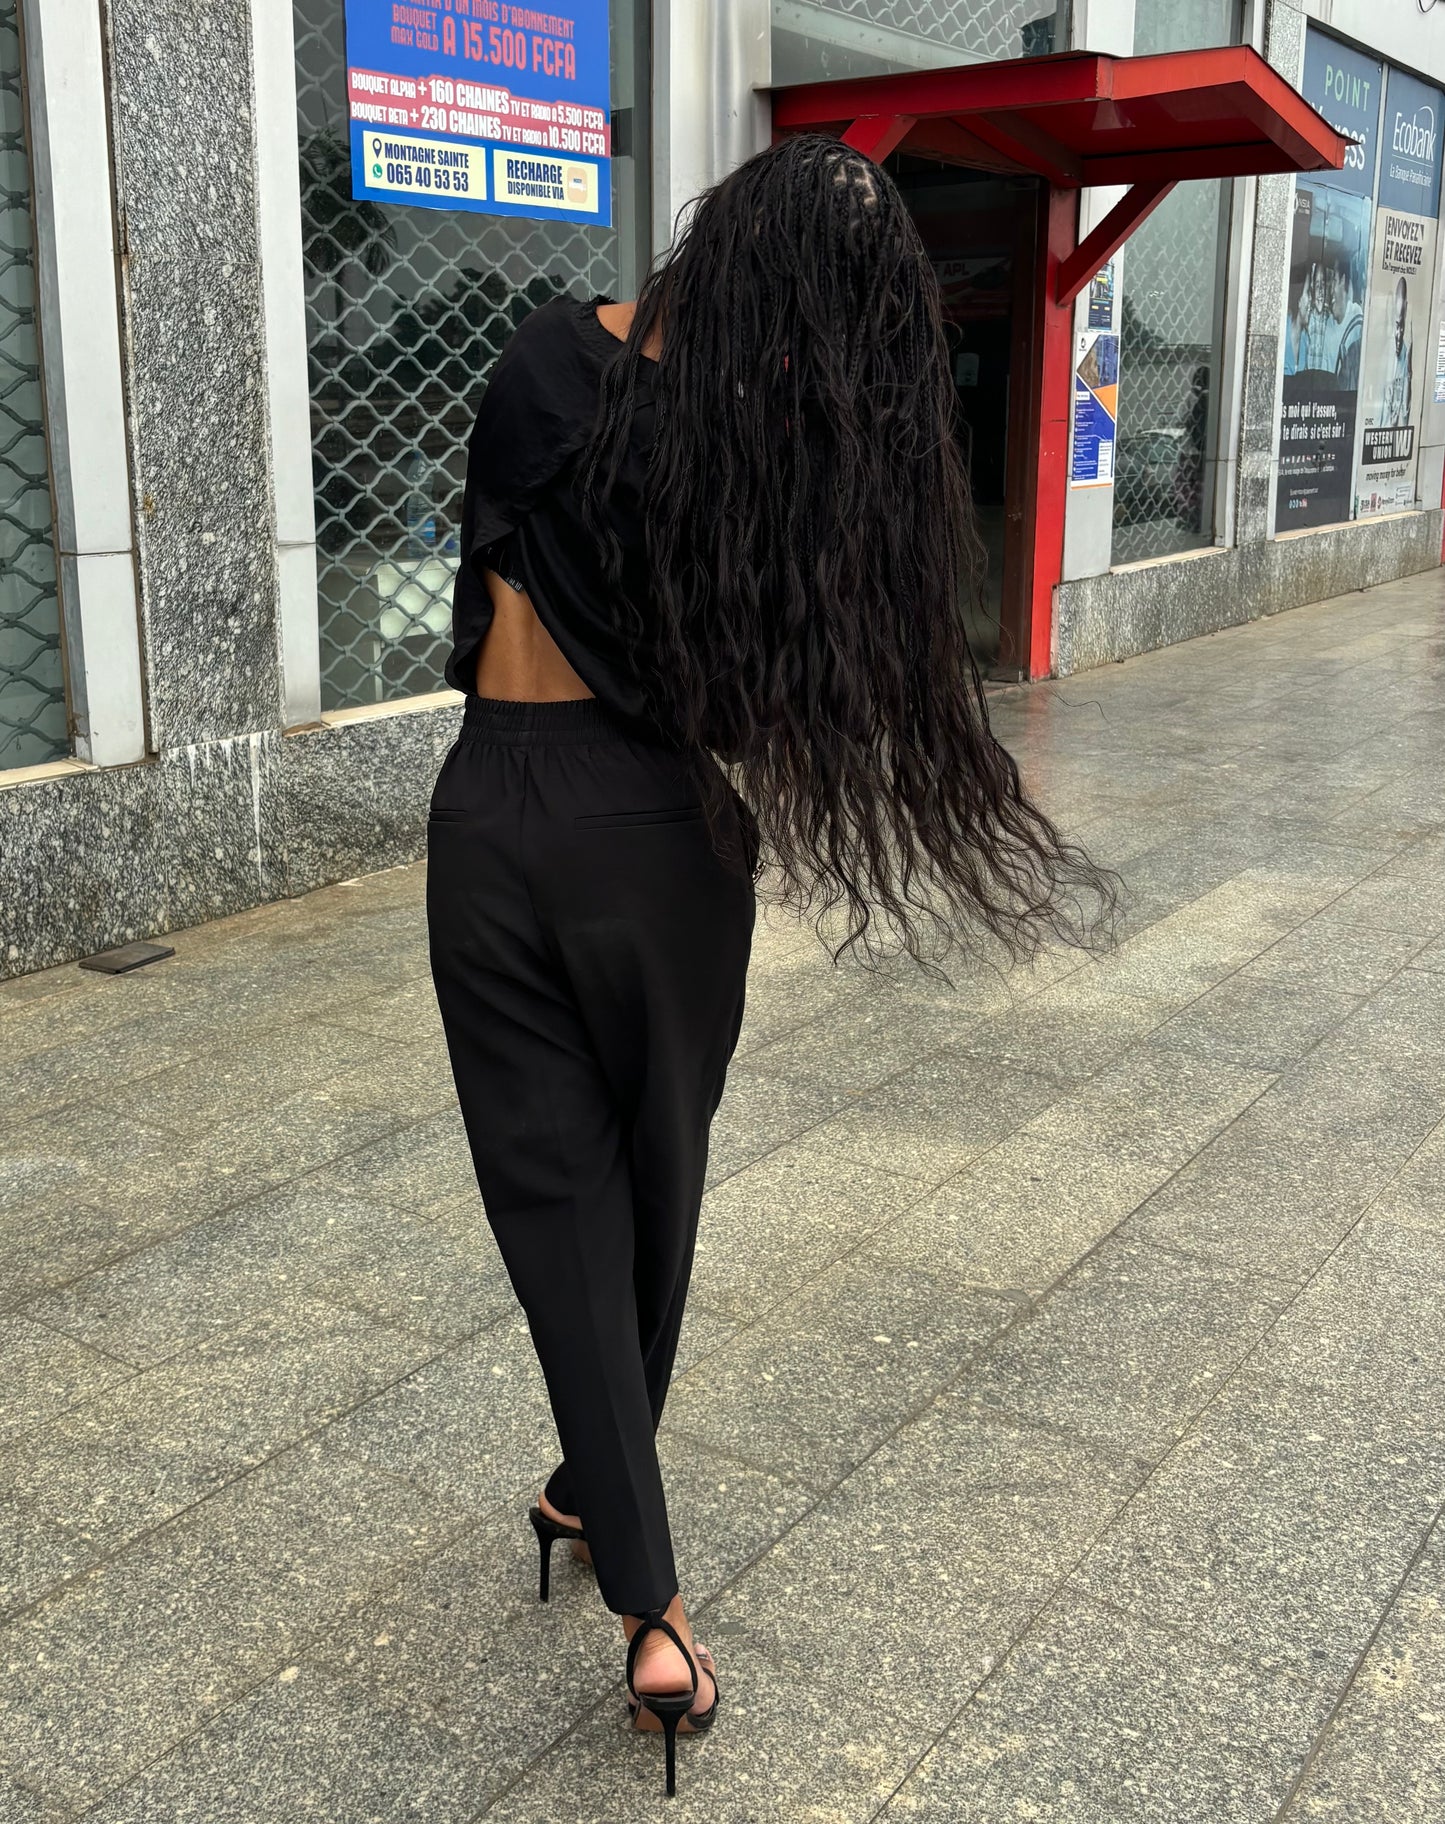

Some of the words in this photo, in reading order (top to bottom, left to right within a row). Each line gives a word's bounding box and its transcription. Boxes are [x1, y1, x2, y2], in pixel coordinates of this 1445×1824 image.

[392, 3, 437, 31] BOUQUET
[472, 0, 498, 22] MOIS
[501, 3, 575, 40] D'ABONNEMENT
[391, 25, 413, 47] MAX
[416, 30, 439, 52] GOLD
[443, 16, 456, 57] A
[462, 19, 526, 70] 15.500
[532, 35, 576, 80] FCFA
[351, 72, 390, 95] BOUQUET
[390, 79, 416, 98] ALPHA
[418, 81, 428, 96] +
[428, 79, 454, 105] 160
[456, 83, 510, 114] CHAINES
[510, 100, 520, 116] TV
[521, 102, 530, 118] ET
[531, 104, 551, 122] RADIO
[558, 104, 582, 127] 5.500
[584, 110, 604, 131] FCFA
[1324, 64, 1370, 112] POINT
[351, 101, 388, 123] BOUQUET
[388, 107, 408, 126] BETA
[410, 108, 420, 122] +
[421, 105, 447, 130] 230
[449, 110, 502, 140] CHAINES
[502, 125, 512, 140] TV
[512, 127, 522, 142] ET
[522, 128, 542, 146] RADIO
[548, 125, 581, 152] 10.500
[582, 131, 606, 156] FCFA
[1392, 106, 1436, 162] Ecobank
[384, 142, 436, 164] MONTAGNE
[438, 149, 470, 168] SAINTE
[386, 162, 412, 186] 065
[416, 166, 432, 188] 40
[434, 168, 450, 190] 53
[453, 170, 469, 192] 53
[506, 158, 563, 185] RECHARGE
[508, 180, 551, 199] DISPONIBLE
[552, 186, 565, 200] VIA
[1388, 216, 1420, 242] ENVOYEZ
[1386, 240, 1394, 260] ET
[1394, 242, 1422, 266] RECEVEZ
[944, 263, 970, 277] APL
[1288, 401, 1300, 418] moi
[1301, 401, 1312, 421] qui
[1283, 424, 1289, 440] te
[1291, 424, 1308, 440] dirais
[1310, 424, 1316, 440] si
[1317, 423, 1331, 439] c'est
[1365, 430, 1393, 446] WESTERN
[1372, 444, 1392, 460] UNION
